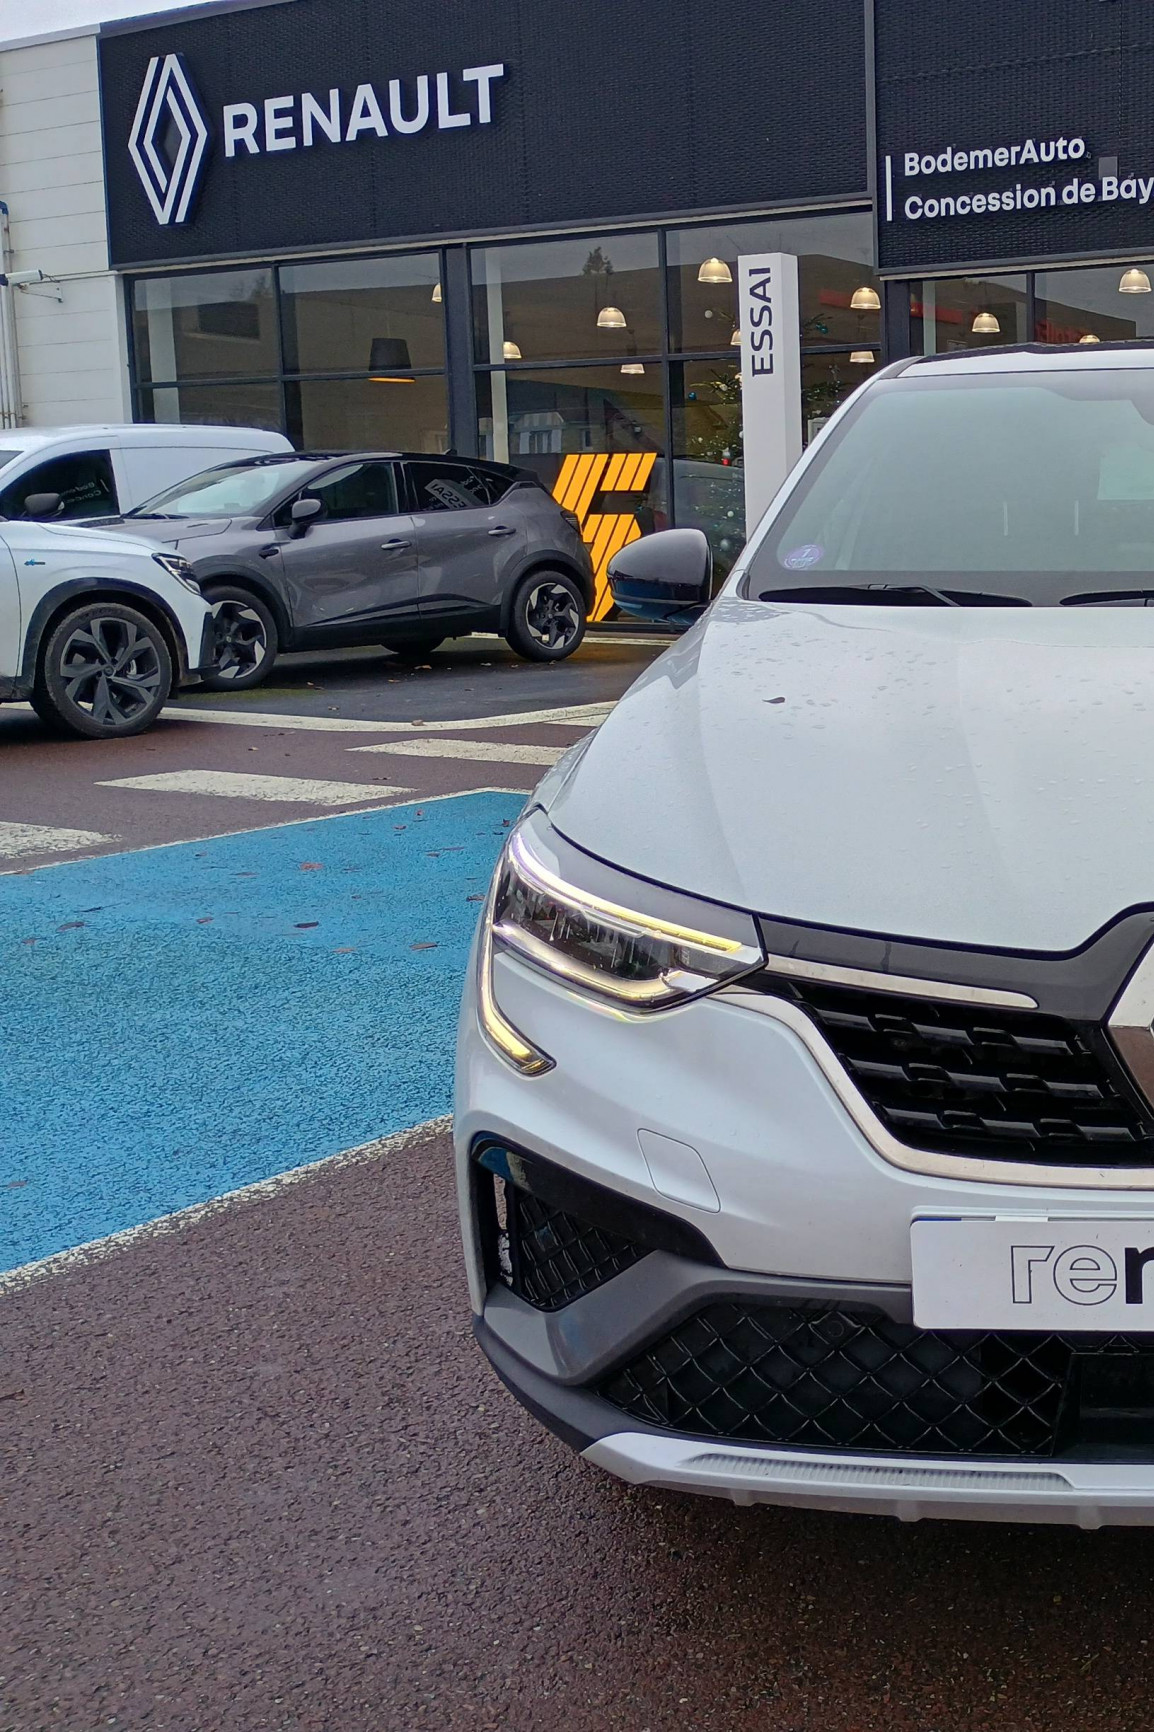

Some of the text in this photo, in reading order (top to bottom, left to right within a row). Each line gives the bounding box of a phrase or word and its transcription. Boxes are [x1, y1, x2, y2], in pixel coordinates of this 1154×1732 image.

[223, 64, 504, 157] RENAULT
[904, 137, 1085, 176] BodemerAuto
[904, 184, 1056, 220] Concession
[1061, 178, 1096, 205] de
[748, 267, 774, 377] ESSAI
